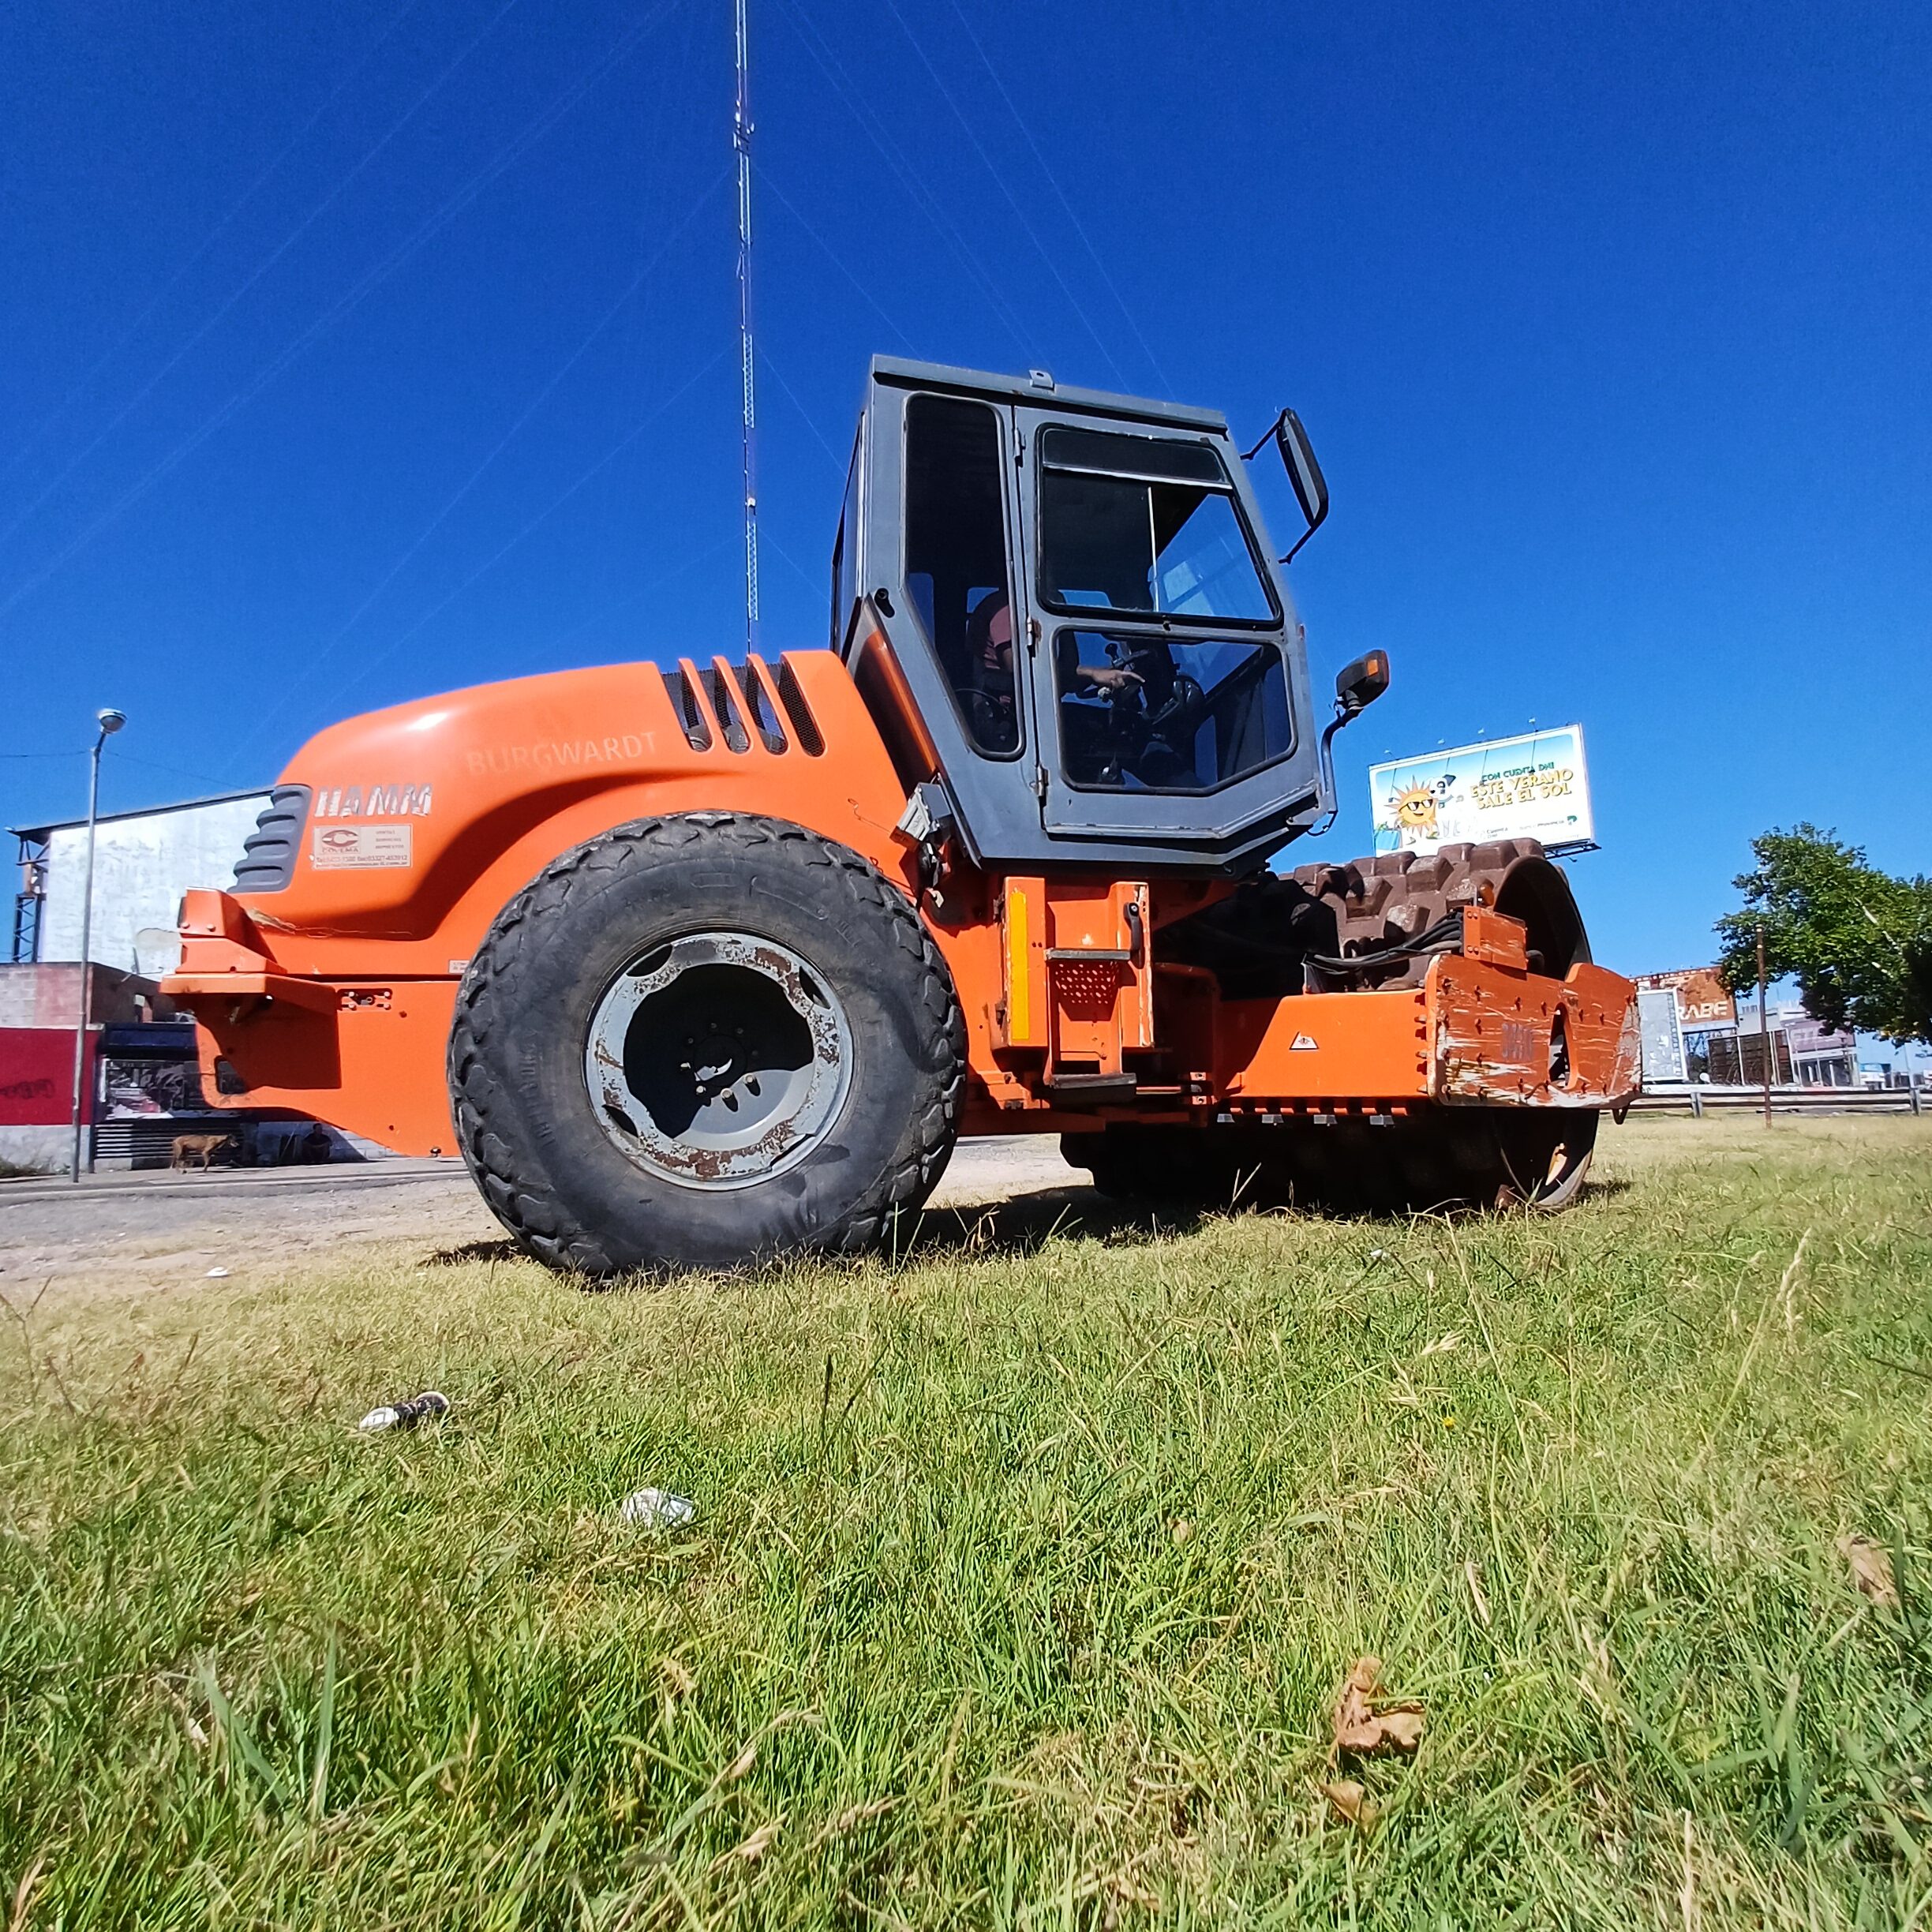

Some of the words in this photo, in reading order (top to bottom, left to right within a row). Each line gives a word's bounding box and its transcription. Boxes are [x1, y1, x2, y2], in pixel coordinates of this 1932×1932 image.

[466, 731, 657, 777] BURGWARDT
[1470, 781, 1504, 798] ESTE
[1509, 769, 1574, 790] VERANO
[1481, 772, 1501, 782] CON
[1538, 762, 1555, 772] DNI
[315, 783, 432, 818] HAMM
[1477, 792, 1514, 810] SALE
[1518, 788, 1536, 803] EL
[1541, 783, 1572, 799] SOL
